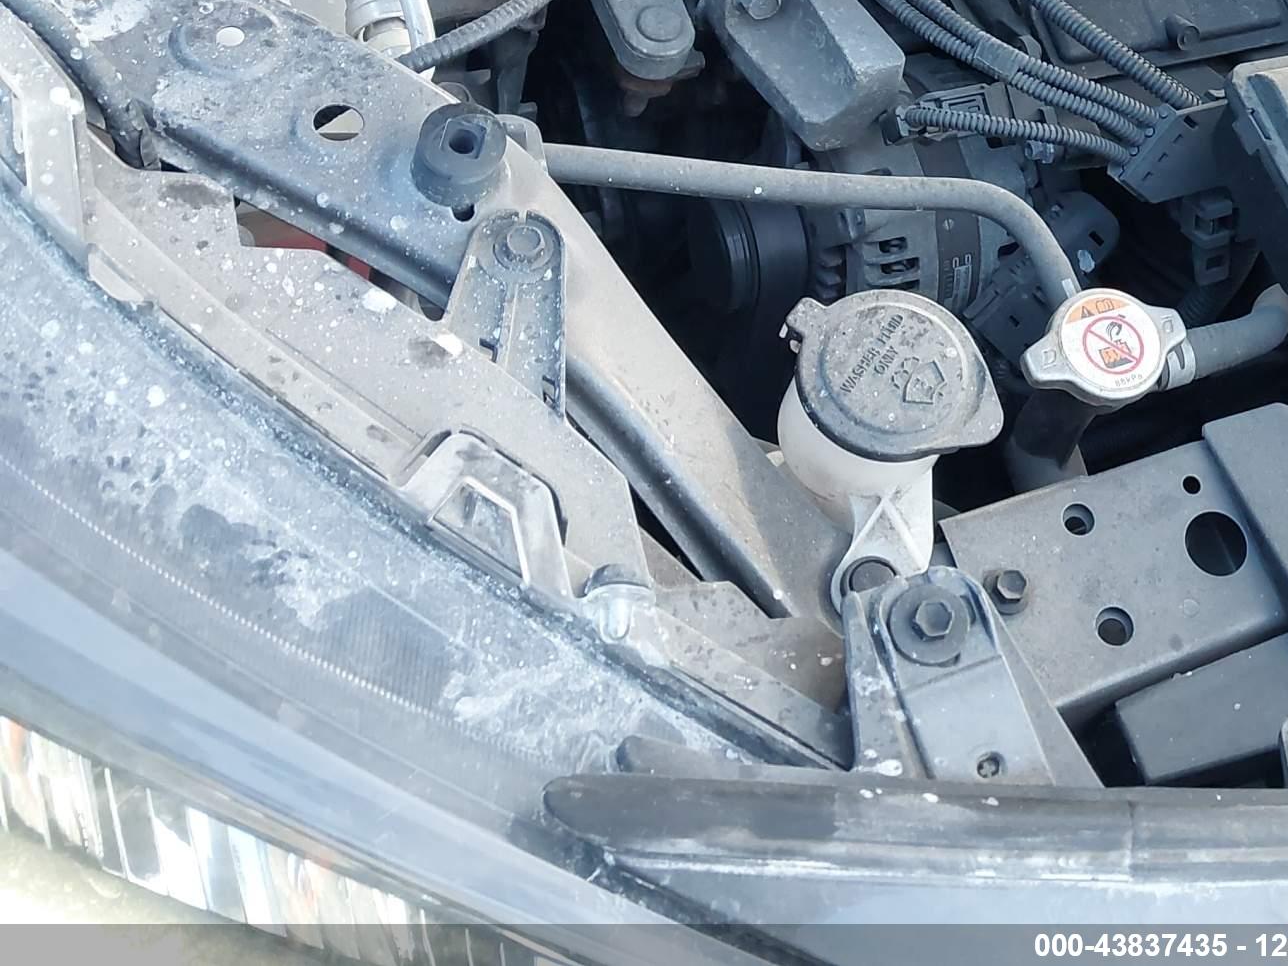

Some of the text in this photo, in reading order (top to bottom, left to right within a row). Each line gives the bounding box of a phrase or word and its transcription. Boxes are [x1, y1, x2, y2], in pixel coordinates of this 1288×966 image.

[840, 314, 904, 393] WASHER FLUID
[874, 345, 899, 375] ONLY
